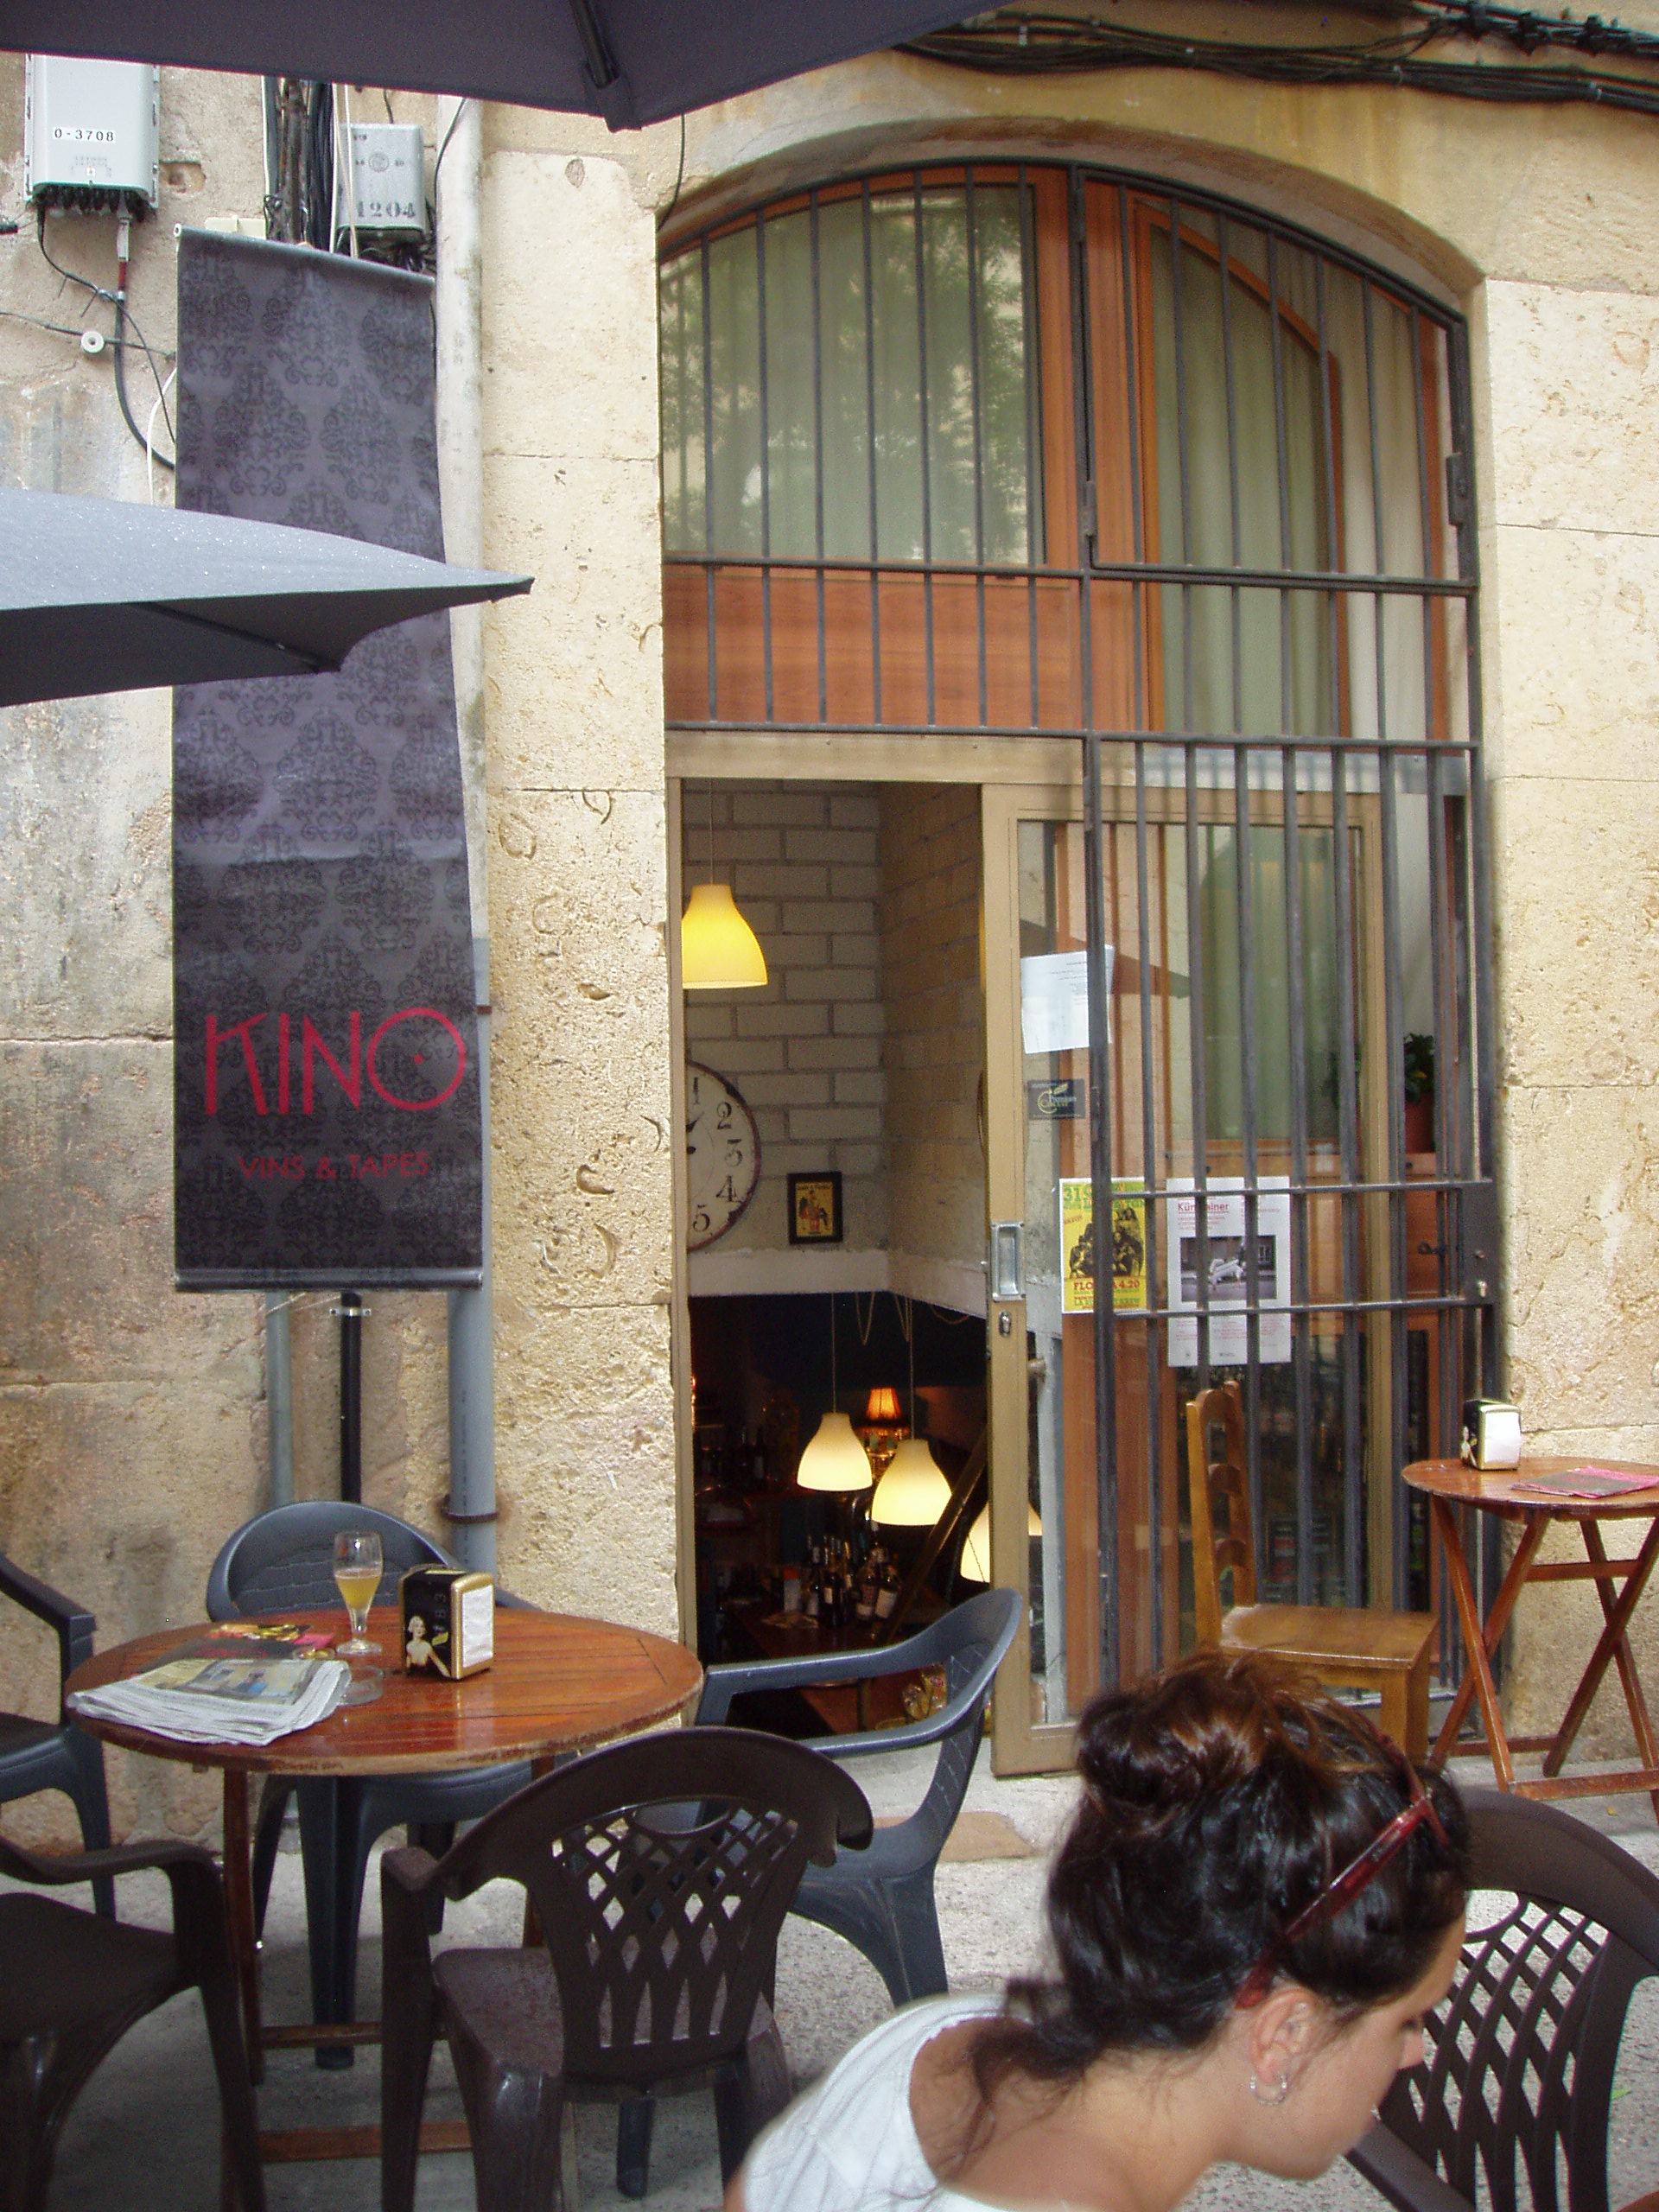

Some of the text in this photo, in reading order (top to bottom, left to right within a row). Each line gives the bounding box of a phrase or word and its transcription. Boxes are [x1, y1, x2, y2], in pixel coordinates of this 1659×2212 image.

[54, 128, 114, 142] 0-3708
[357, 201, 416, 218] 1204
[206, 1007, 466, 1115] KINO
[717, 1102, 732, 1130] 2
[238, 1152, 429, 1180] VINS & TAPES
[716, 1176, 741, 1203] 4
[693, 1205, 710, 1232] 5
